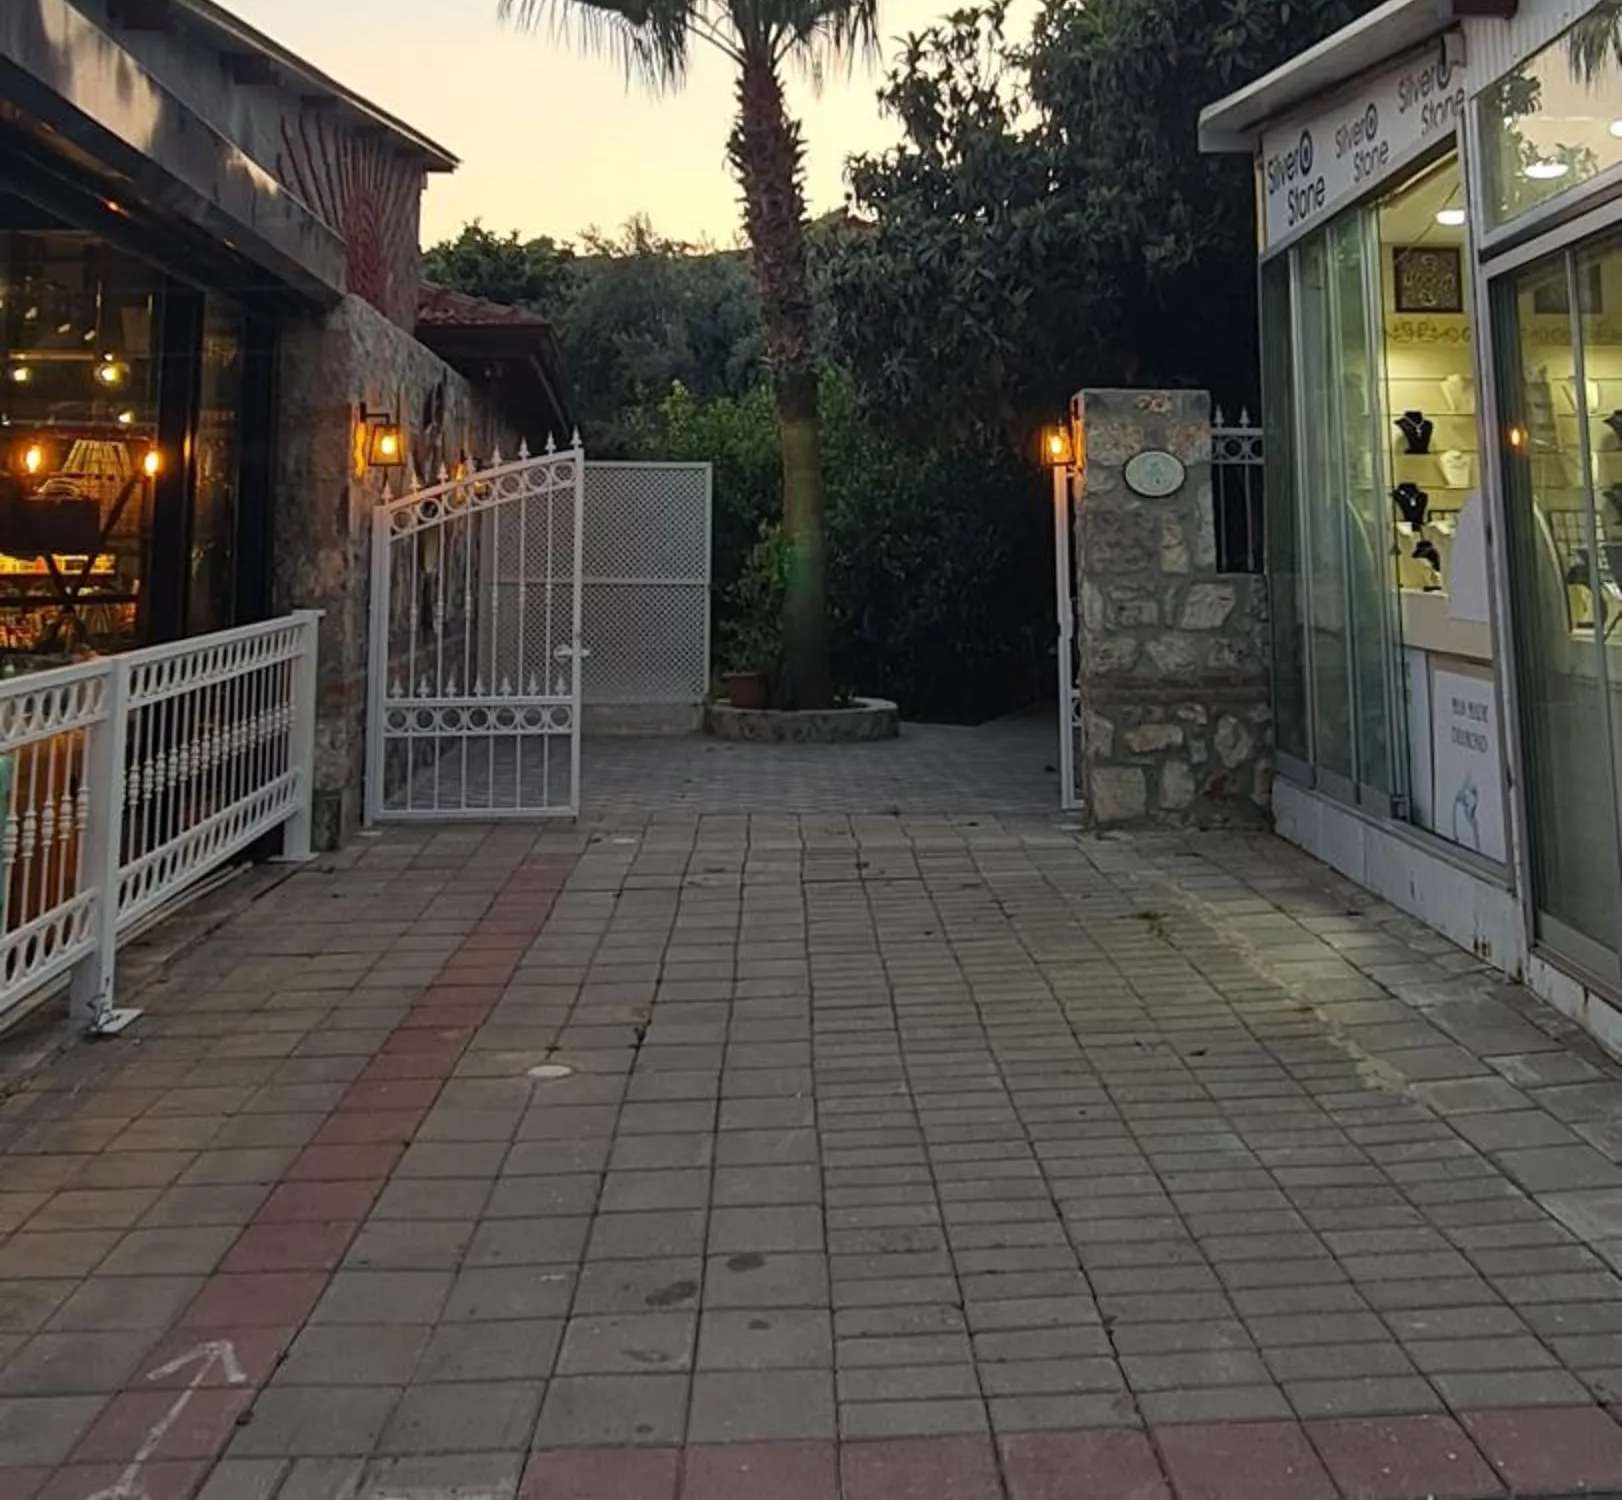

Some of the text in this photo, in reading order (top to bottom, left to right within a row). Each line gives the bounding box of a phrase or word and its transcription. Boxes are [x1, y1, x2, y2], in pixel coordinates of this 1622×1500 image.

[1335, 117, 1366, 159] Silver
[1267, 146, 1299, 196] Silver
[1354, 140, 1389, 183] Stone
[1287, 175, 1325, 227] Stone
